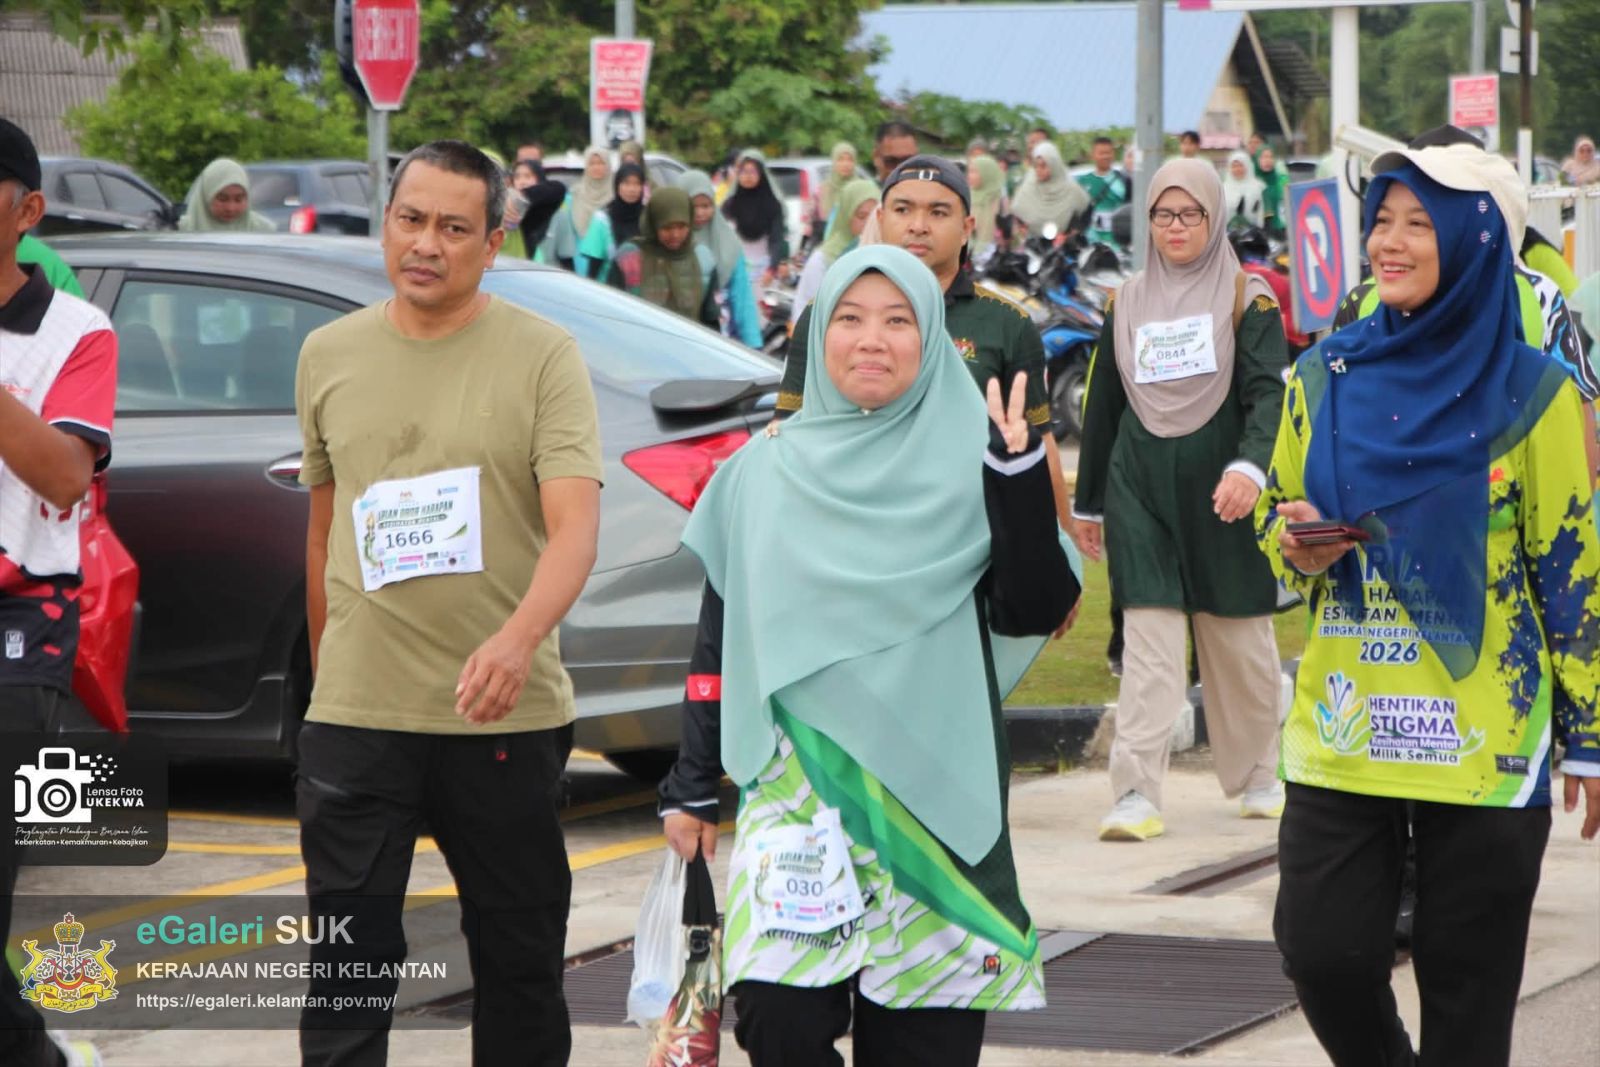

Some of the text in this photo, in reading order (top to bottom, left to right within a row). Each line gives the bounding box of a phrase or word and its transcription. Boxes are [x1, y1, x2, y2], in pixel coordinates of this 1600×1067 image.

[1156, 348, 1186, 360] 0844
[385, 529, 434, 549] 1666
[1368, 627, 1412, 639] NEGERI
[1360, 641, 1418, 663] 2026
[1369, 696, 1455, 714] HENTIKAN
[1370, 715, 1456, 735] STIGMA
[1370, 748, 1458, 763] Milik Semua
